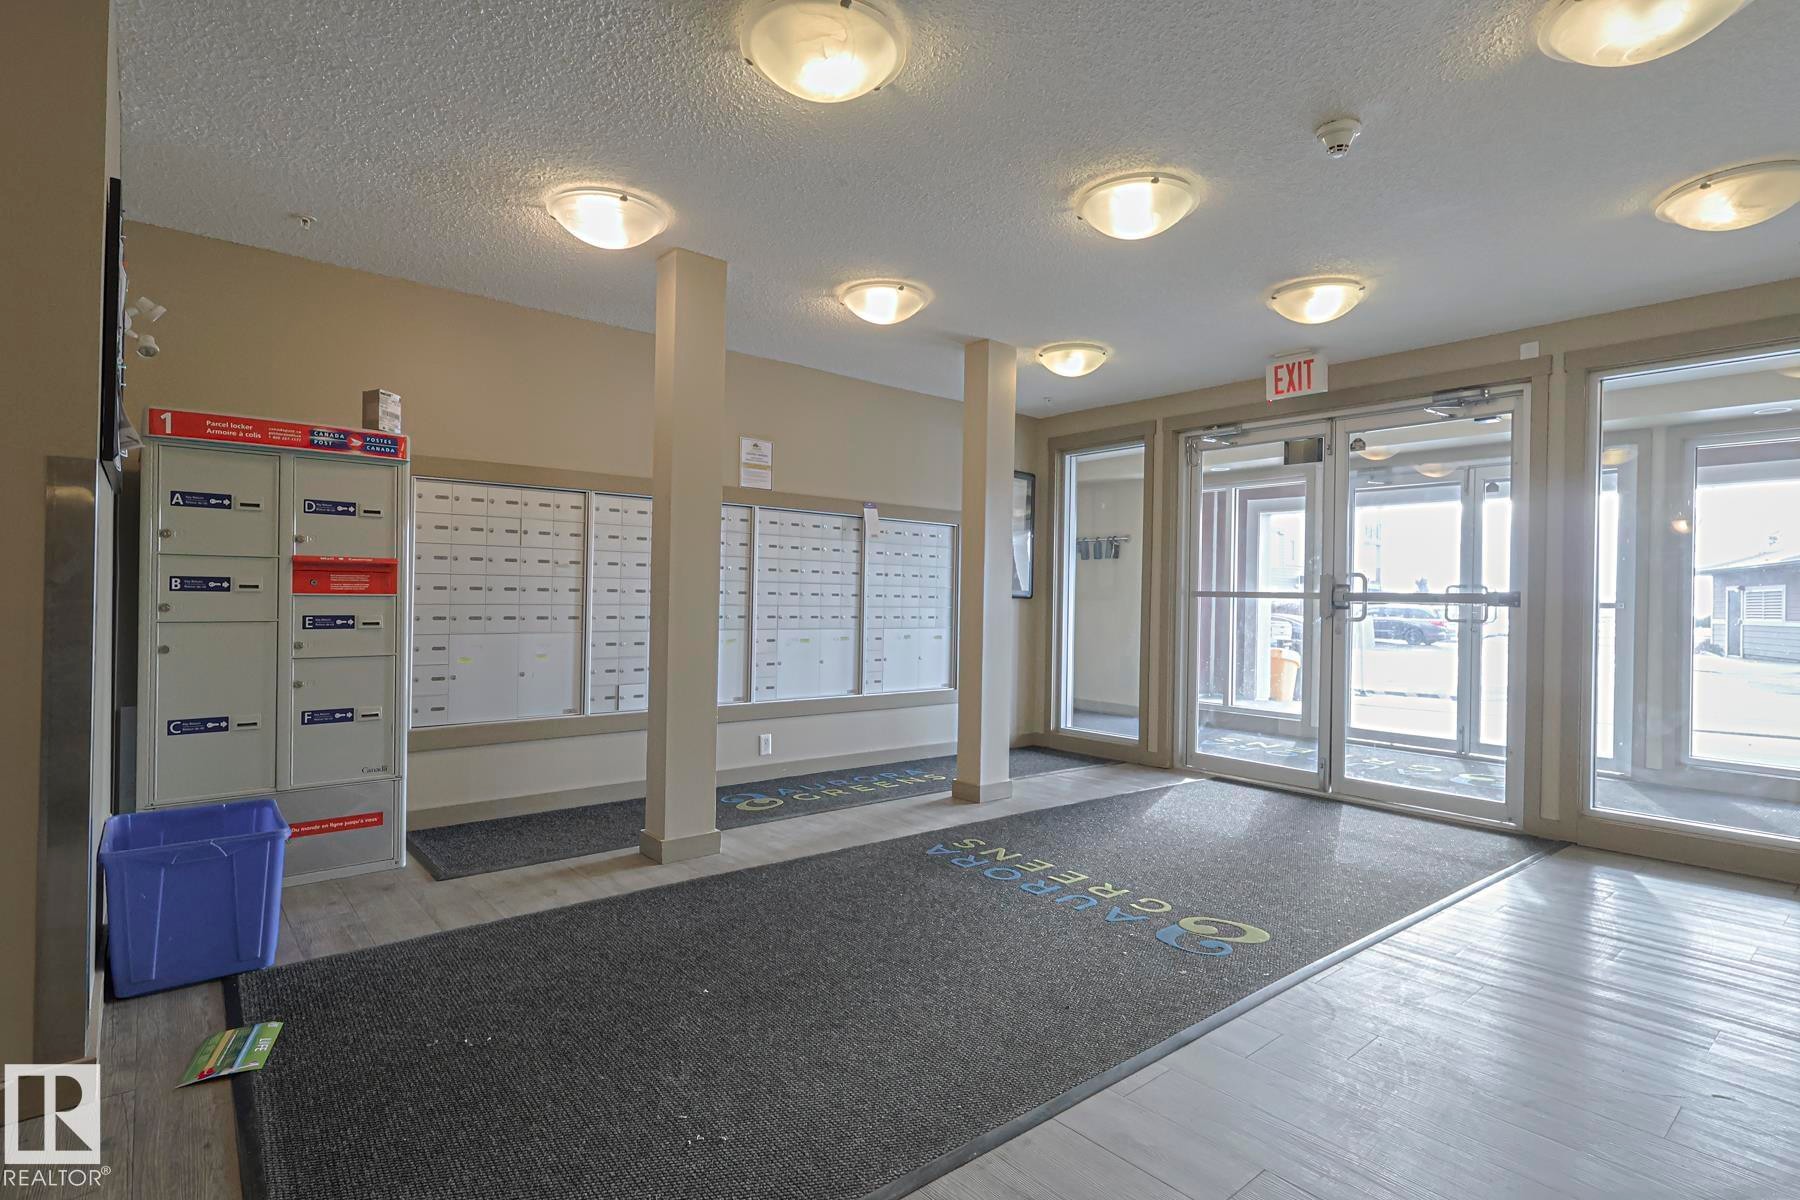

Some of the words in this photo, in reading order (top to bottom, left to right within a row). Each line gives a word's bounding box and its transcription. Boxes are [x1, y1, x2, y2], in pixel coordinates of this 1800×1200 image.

[1273, 358, 1315, 395] EXIT
[160, 412, 172, 434] 1
[206, 419, 229, 429] Parcel
[230, 422, 253, 432] locker
[206, 427, 237, 437] Armoire
[244, 430, 262, 439] colis
[313, 431, 345, 440] CANADA
[313, 439, 332, 447] POST
[366, 437, 392, 445] POSTES
[366, 445, 395, 454] CANADA
[171, 493, 183, 505] A
[305, 501, 316, 512] D
[171, 578, 181, 590] B
[306, 616, 313, 628] E
[304, 712, 312, 724] F
[169, 721, 181, 734] C
[361, 765, 388, 774] Canada
[778, 768, 928, 797] AURORA
[793, 773, 947, 802] GREENS
[301, 824, 321, 832] monde
[329, 821, 344, 829] ligne
[953, 837, 1173, 914] GREENS
[925, 842, 1150, 924] AURORA
